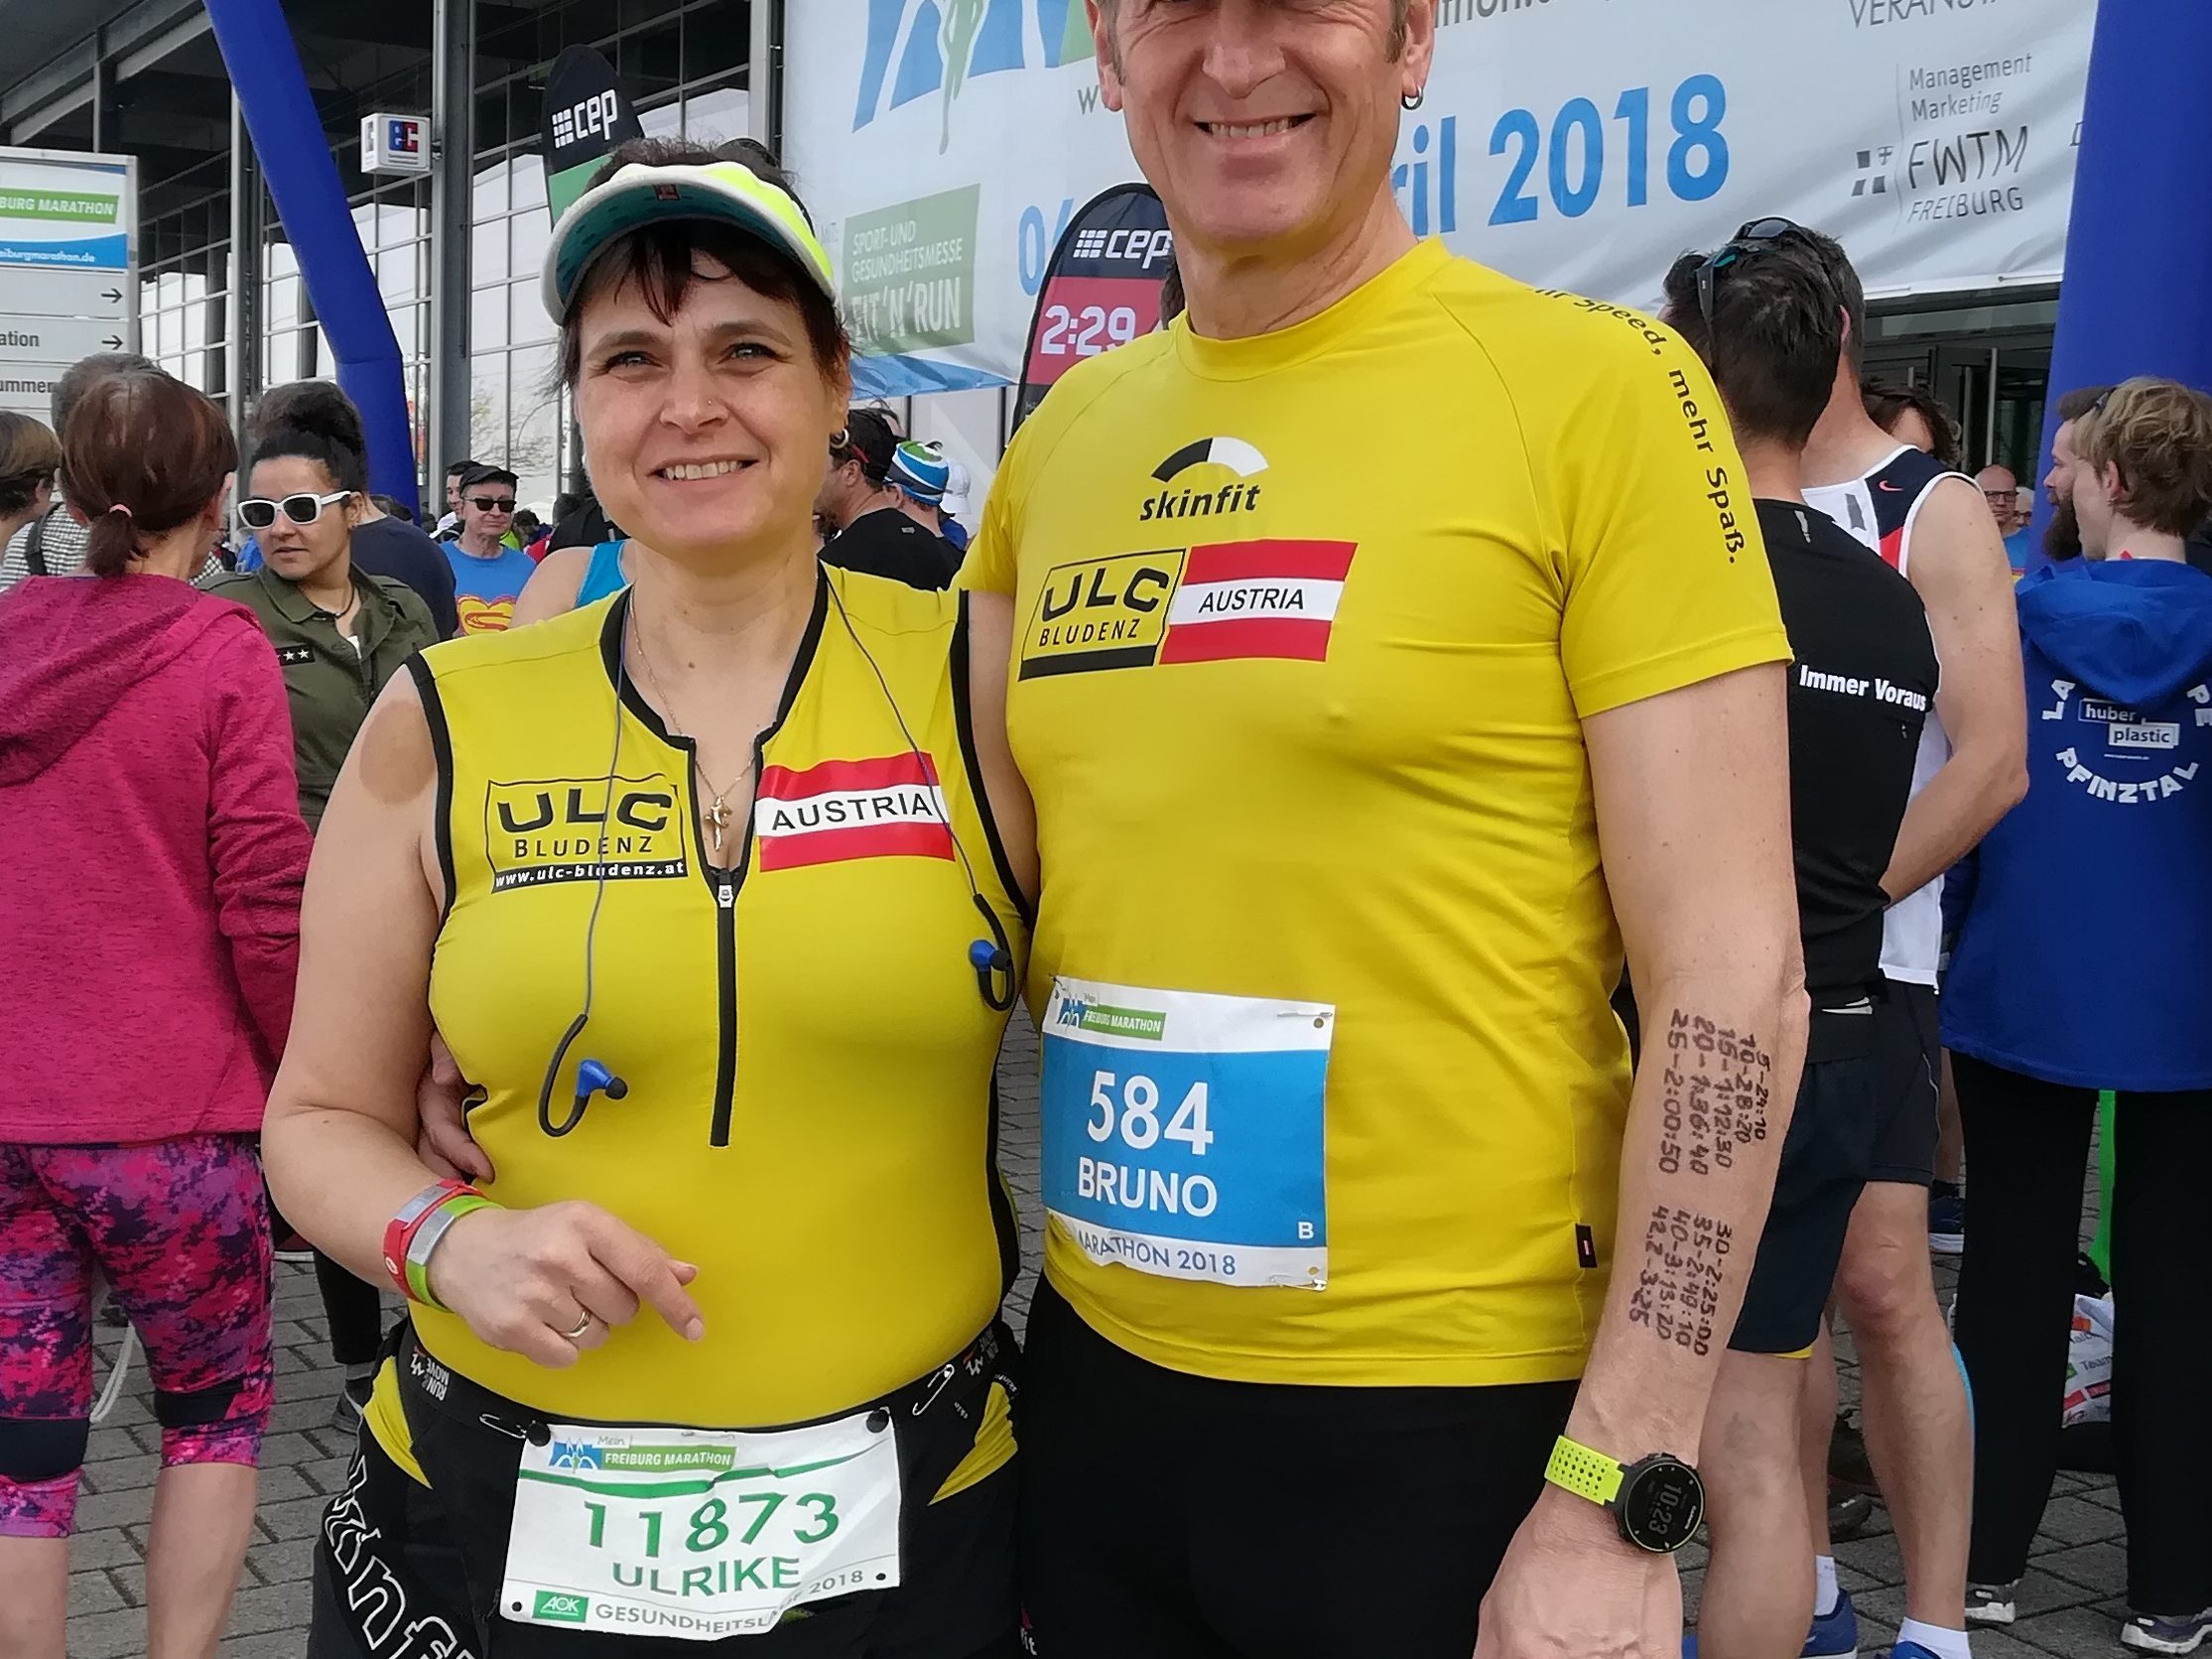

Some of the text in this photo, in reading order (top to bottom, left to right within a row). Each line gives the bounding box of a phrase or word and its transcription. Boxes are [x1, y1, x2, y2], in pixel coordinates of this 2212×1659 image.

[1909, 54, 2031, 90] Management
[574, 89, 618, 140] cep
[1911, 91, 2003, 122] Marketing
[1488, 74, 1729, 226] 2018
[1908, 125, 2027, 189] FWTM
[38, 198, 114, 216] MARATHON
[1907, 187, 2023, 223] FREIBURG
[890, 220, 917, 246] UND
[1106, 229, 1172, 269] cep
[850, 238, 963, 283] GESUNDHEITSMESSE
[1041, 305, 1136, 356] 2:29
[1668, 368, 1714, 453] mehr
[1706, 466, 1745, 564] Spaß.
[1140, 483, 1260, 521] skinfit
[1042, 567, 1304, 622] ULC AUSTRIA
[1039, 619, 1141, 647] BLUDENZ
[1799, 665, 1927, 711] Immer Voraus
[2086, 703, 2137, 721] huber
[2114, 727, 2170, 743] plastic
[2056, 747, 2199, 804] PFINZTAL
[497, 789, 933, 833] ULC AUSTRIA
[514, 836, 653, 858] BLUDENZ
[496, 861, 685, 888] www.ulc-bludenz.at
[1110, 1014, 1162, 1033] MARATHON
[1088, 1070, 1214, 1156] 584
[1078, 1156, 1218, 1217] BRUNO
[1297, 1220, 1315, 1240] B
[1176, 1249, 1236, 1276] 2018
[604, 1452, 731, 1467] FREIBURG MARATHON
[584, 1492, 840, 1559] 11873
[1648, 1483, 1682, 1535] 10:23
[612, 1556, 801, 1598] ULRIKE
[809, 1570, 863, 1595] 2018
[542, 1595, 580, 1611] AOK
